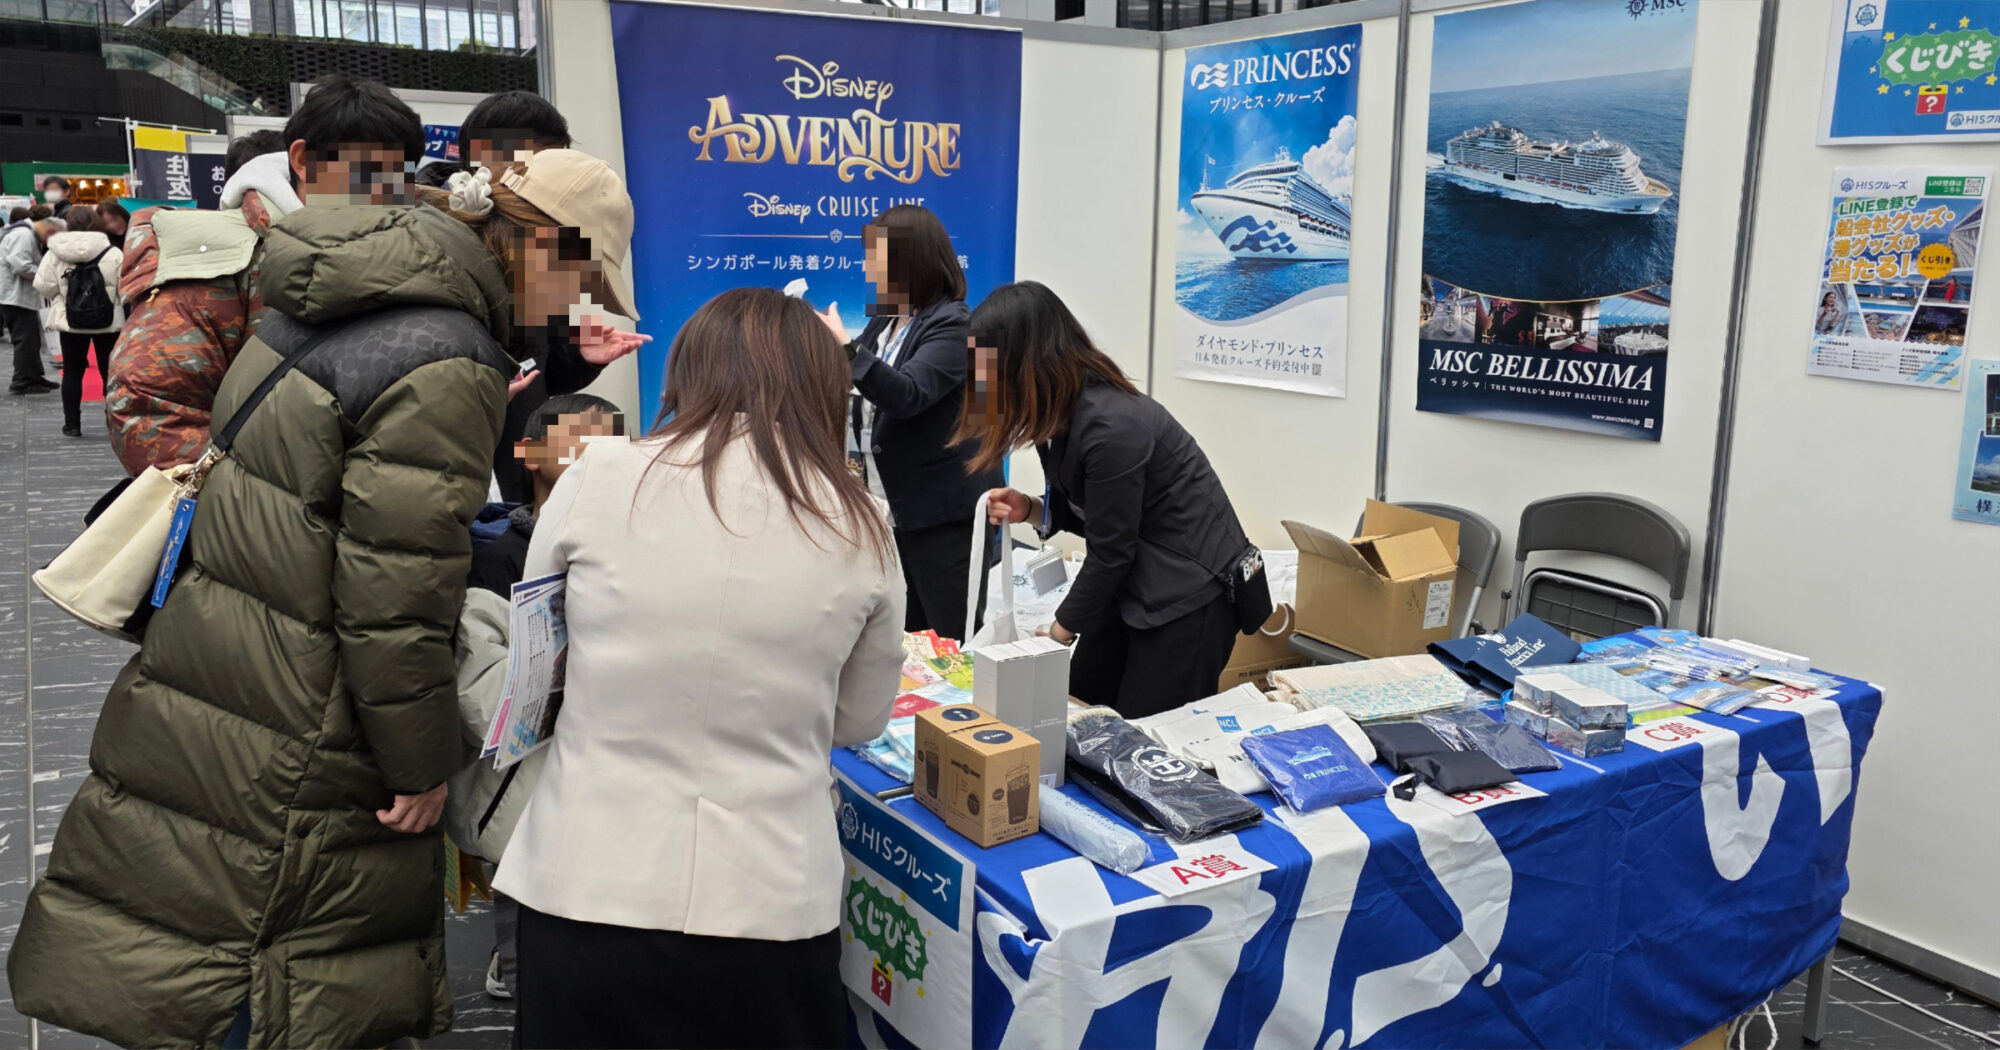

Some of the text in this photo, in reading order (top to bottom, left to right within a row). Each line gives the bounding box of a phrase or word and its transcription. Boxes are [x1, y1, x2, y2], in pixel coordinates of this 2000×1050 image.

[1232, 43, 1353, 86] PRINCESS
[1886, 39, 1993, 74] くじびき
[775, 54, 893, 114] Disney
[1209, 86, 1327, 114] プリンセス・クルーズ
[688, 95, 961, 184] ADVENTURE
[1855, 180, 1909, 190] HISクルーズ
[817, 196, 879, 217] CRUISE
[1839, 195, 1918, 216] LINE登録で
[1196, 334, 1323, 359] ダイヤモンド・プリンセス
[1195, 352, 1310, 374] 日本発着クルーズ予約受付中
[1429, 348, 1654, 391] MSC BELLISSIMA
[1491, 383, 1507, 391] THE
[1549, 389, 1572, 399] MOST
[1574, 393, 1625, 404] BEAUTIFUL
[1627, 398, 1651, 407] SHIP
[1218, 719, 1239, 728] NCL
[1644, 722, 1707, 742] C賞
[861, 820, 953, 902] HISクルーズ
[1169, 854, 1249, 885] A賞
[851, 892, 923, 971] くじびき
